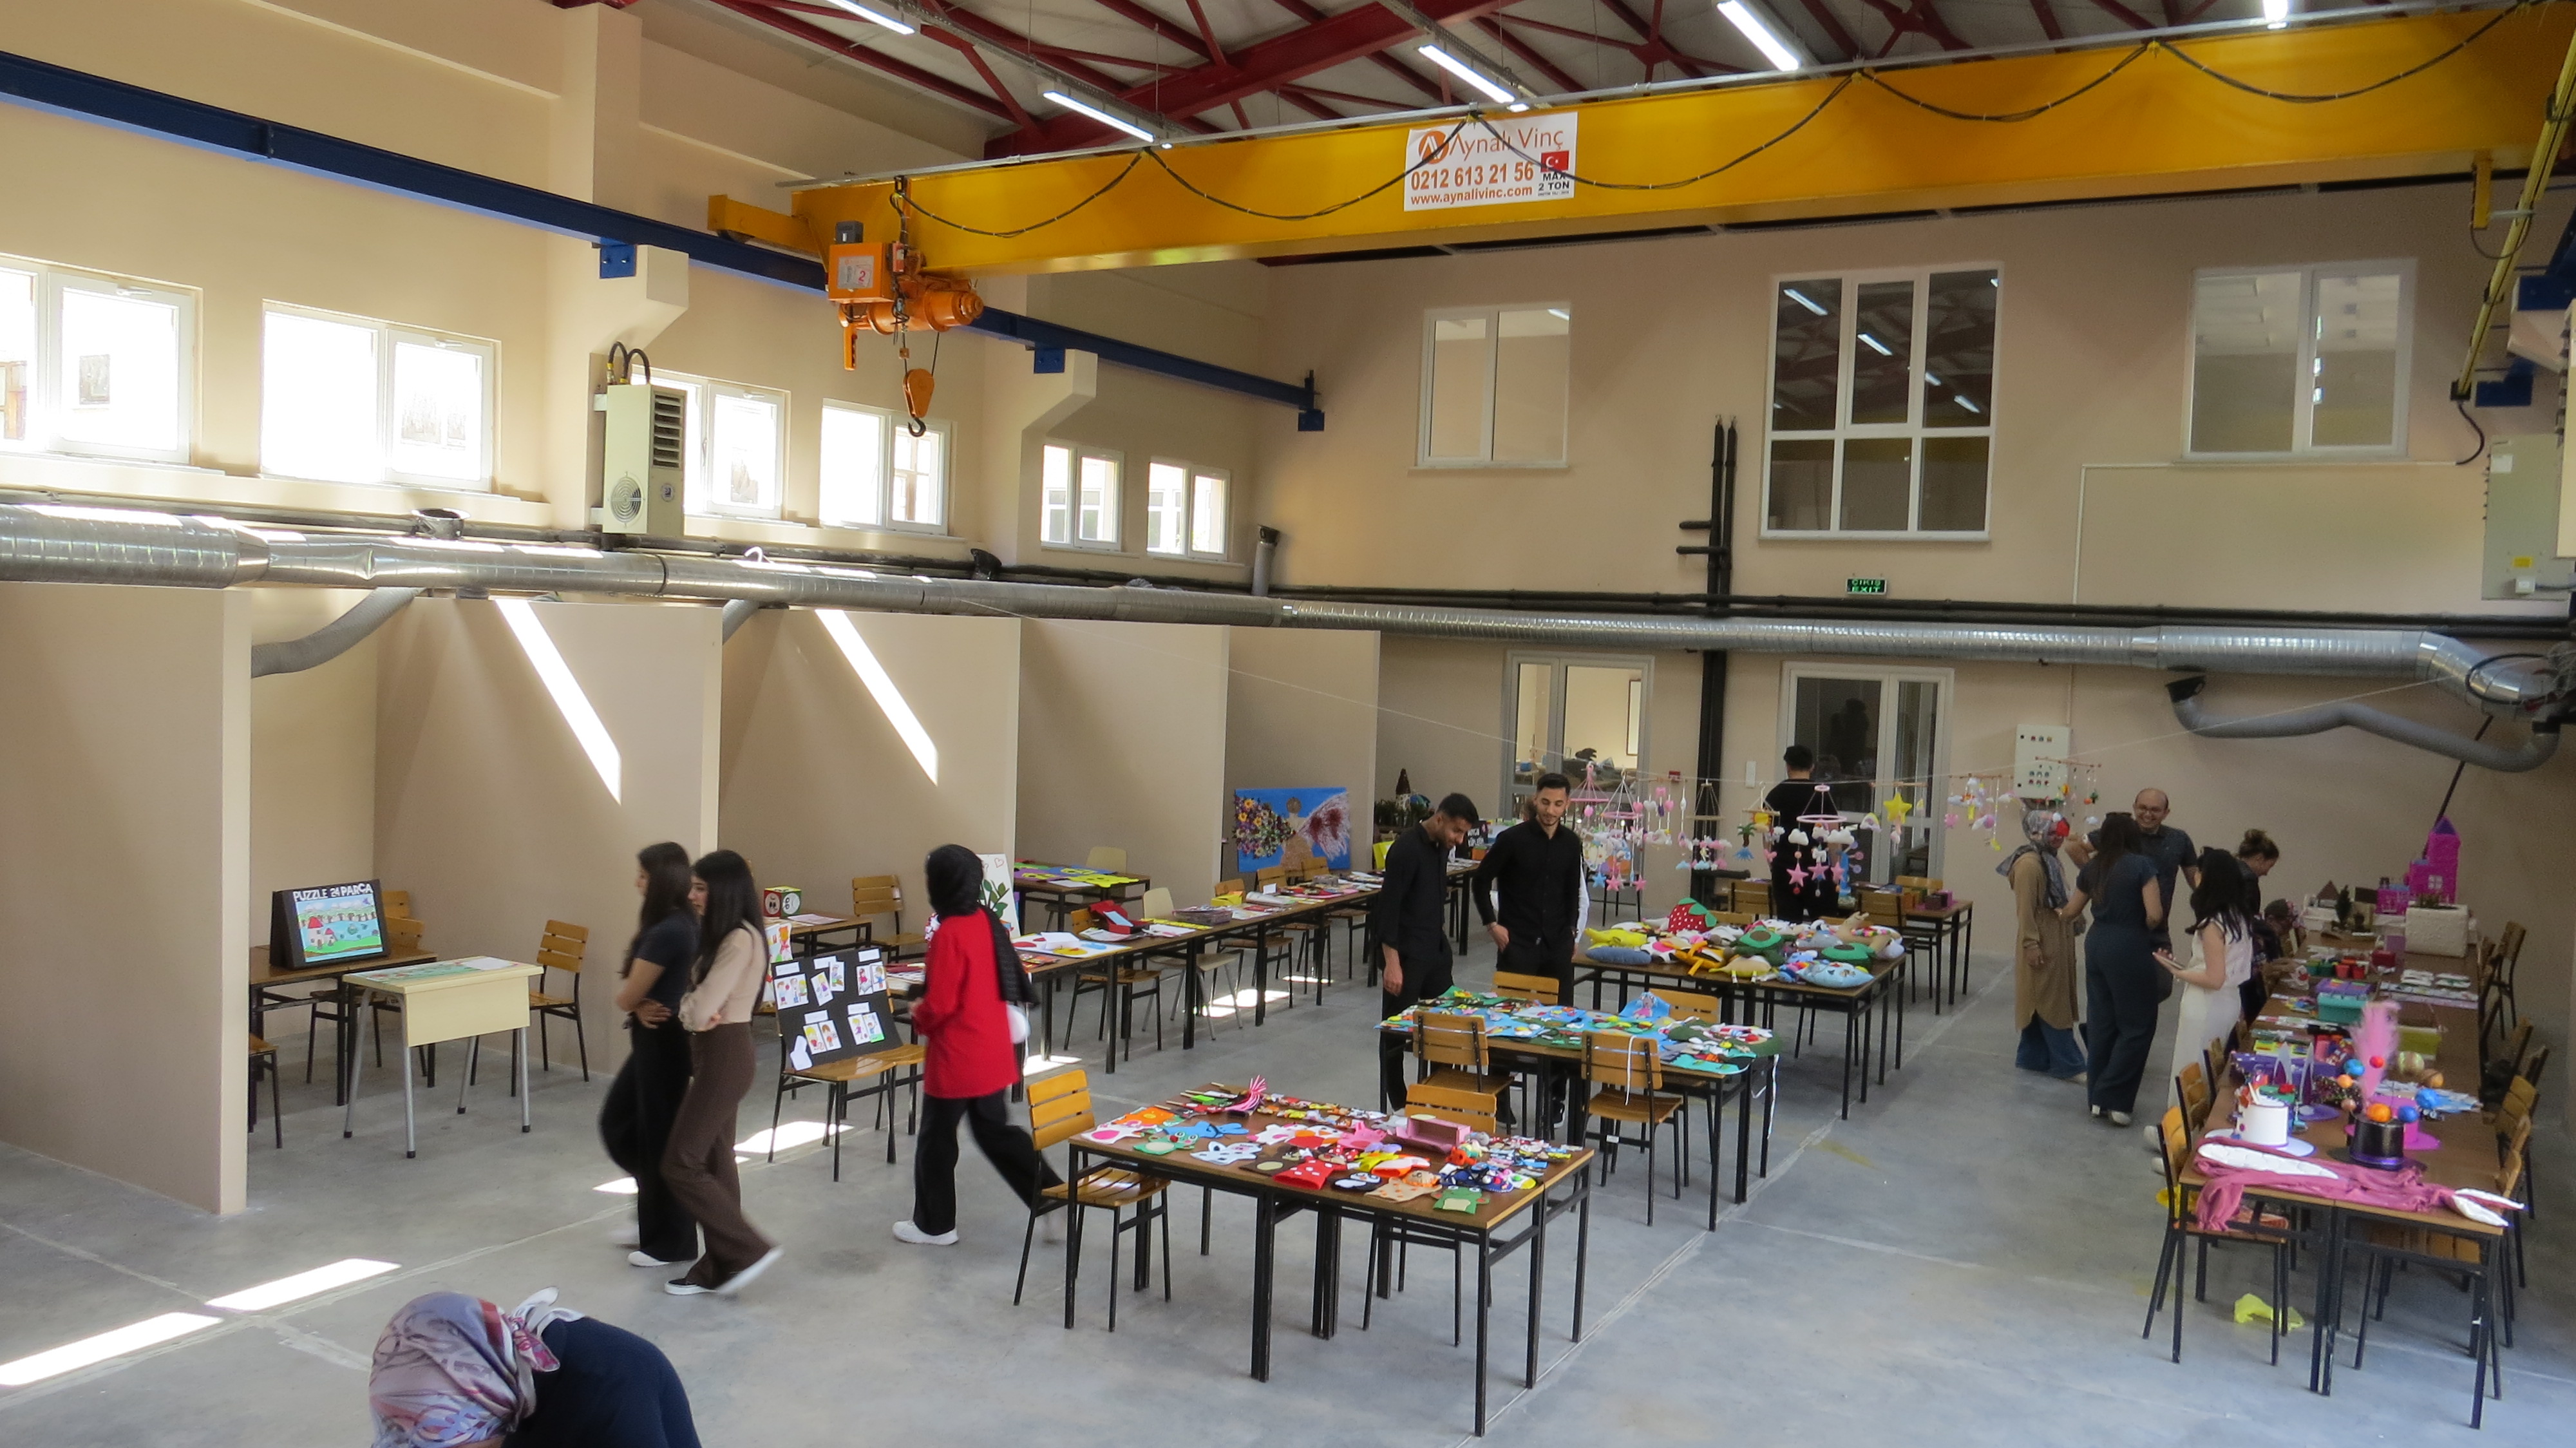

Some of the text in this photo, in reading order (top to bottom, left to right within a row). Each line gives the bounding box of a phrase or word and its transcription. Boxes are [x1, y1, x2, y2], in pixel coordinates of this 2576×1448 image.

[1518, 127, 1564, 150] Vinç
[1411, 161, 1533, 191] 0212 613 21 56
[1539, 181, 1569, 191] 2 TON
[1411, 186, 1533, 205] www.aynalivinc.com
[858, 270, 866, 282] 2
[293, 889, 328, 902] PUZZLE
